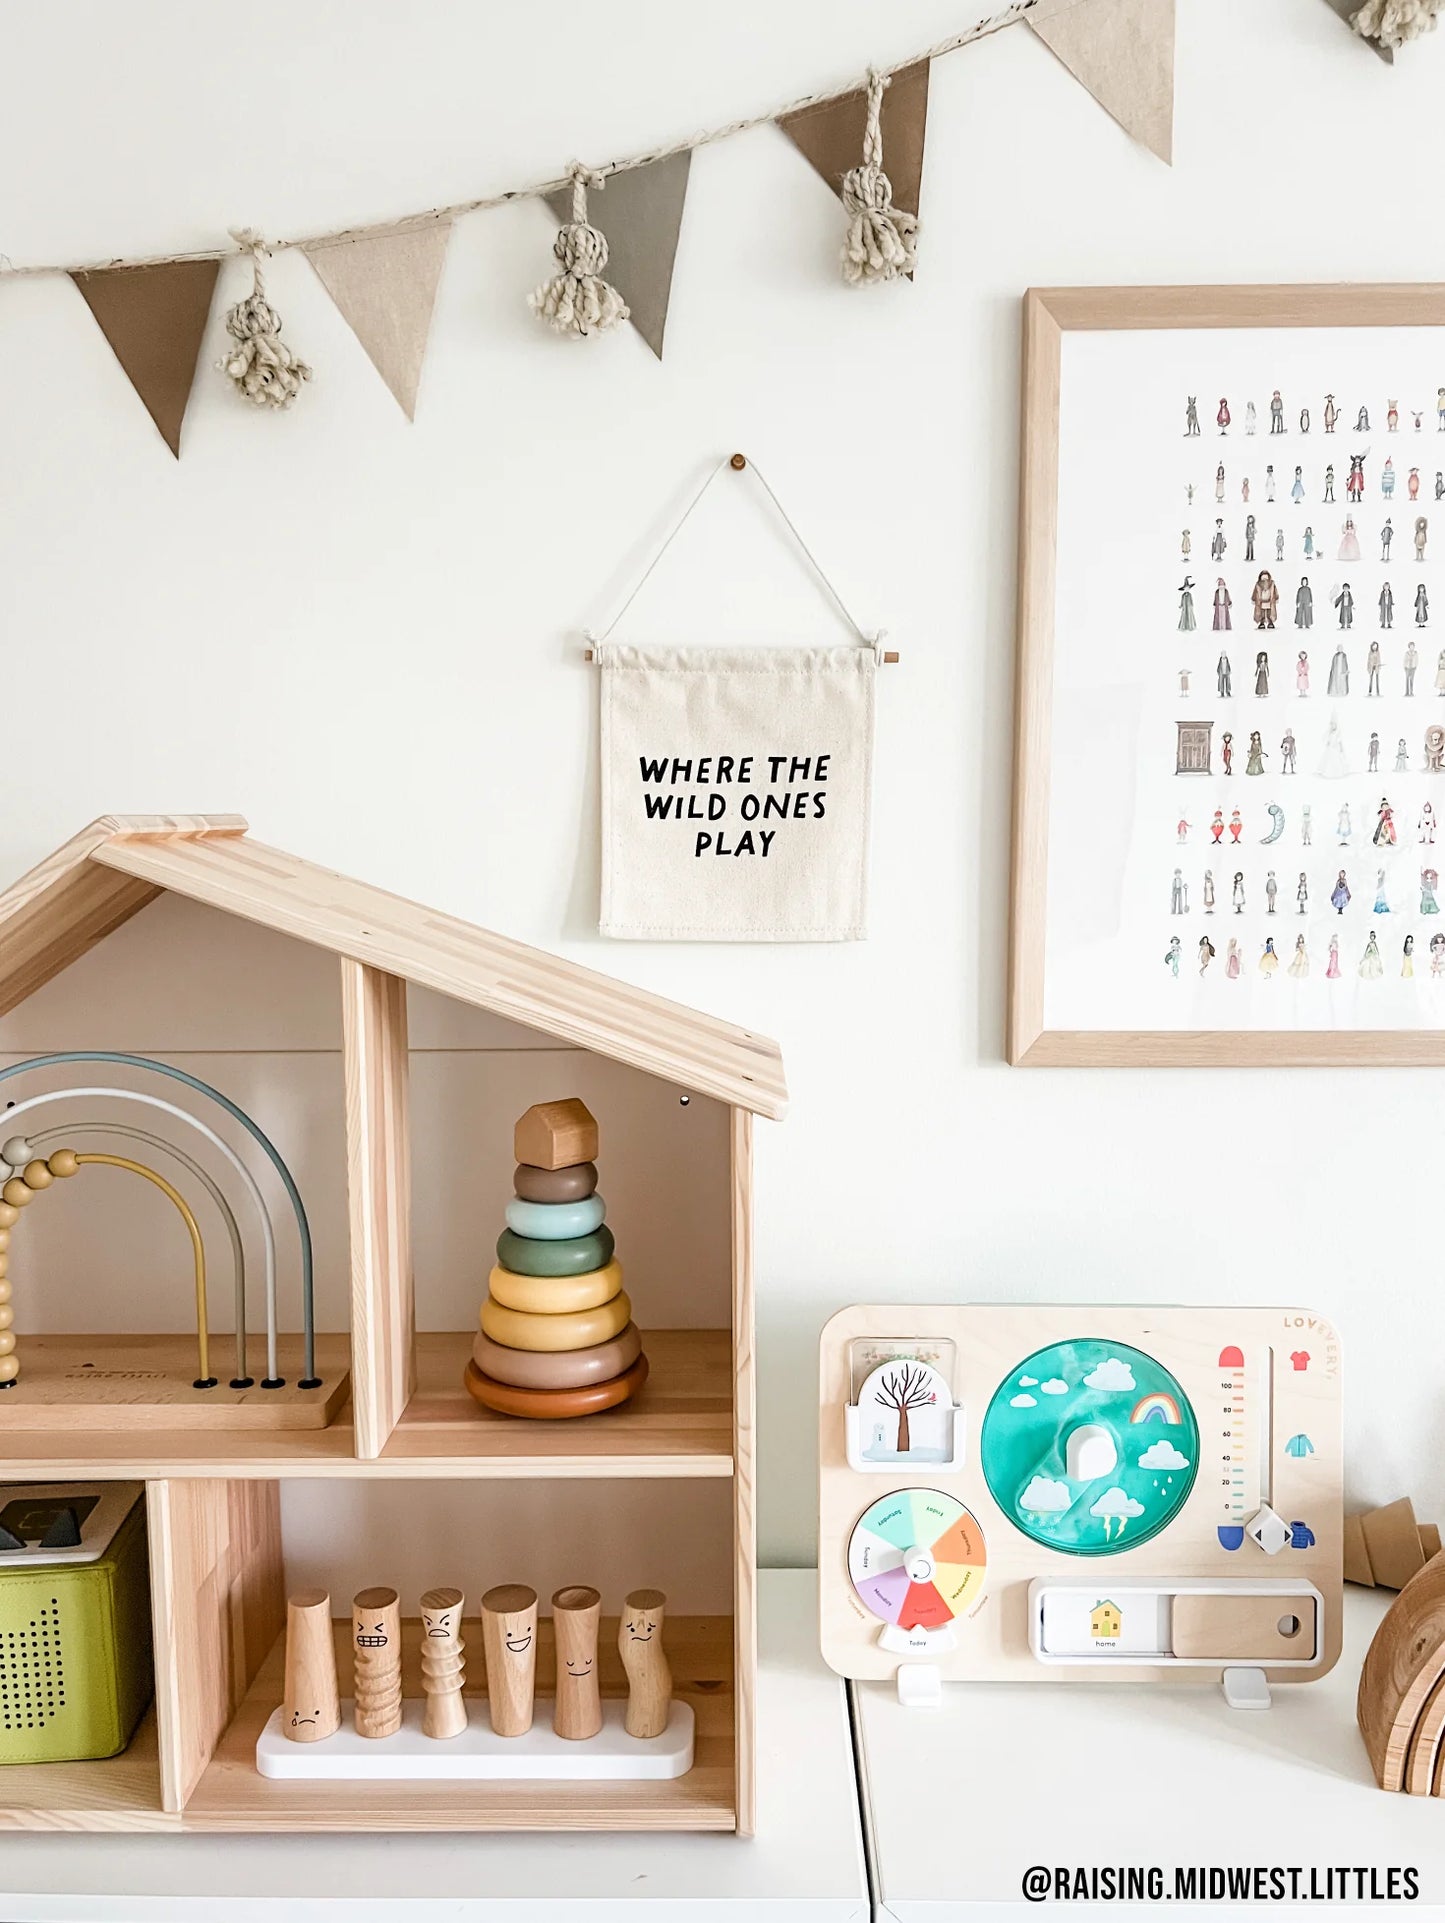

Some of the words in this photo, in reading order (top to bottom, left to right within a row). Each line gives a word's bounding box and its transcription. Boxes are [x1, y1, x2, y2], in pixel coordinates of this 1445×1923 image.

[639, 756, 754, 784] WHERE
[768, 754, 831, 783] THE
[644, 793, 726, 821] WILD
[740, 792, 827, 821] ONES
[695, 830, 776, 857] PLAY
[878, 1509, 903, 1526] Saturday
[926, 1506, 944, 1517] Friday
[863, 1547, 871, 1568] Sunday
[874, 1588, 892, 1607] Monday
